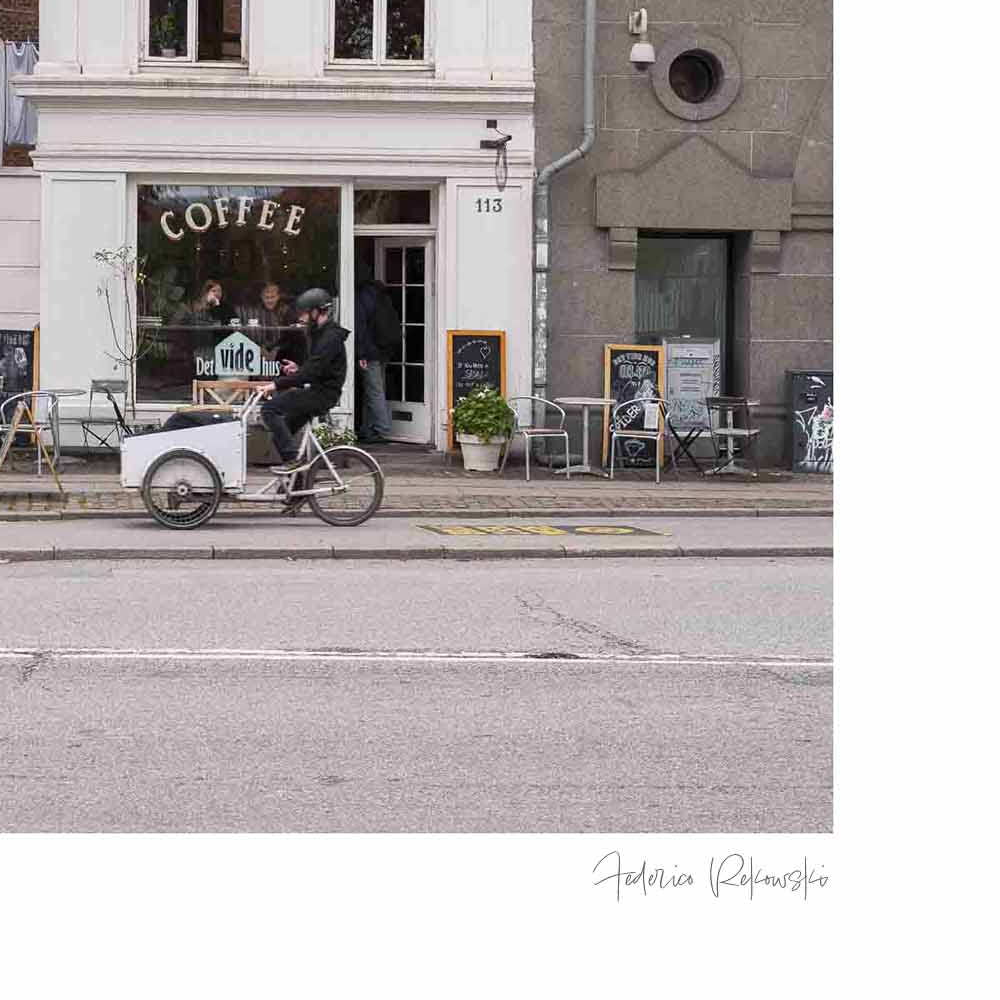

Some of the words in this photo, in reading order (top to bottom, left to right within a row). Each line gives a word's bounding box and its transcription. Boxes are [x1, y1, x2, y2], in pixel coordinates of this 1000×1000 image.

[160, 196, 305, 240] COFFEE
[475, 198, 503, 212] 113
[220, 342, 254, 372] vide
[261, 356, 281, 376] hus
